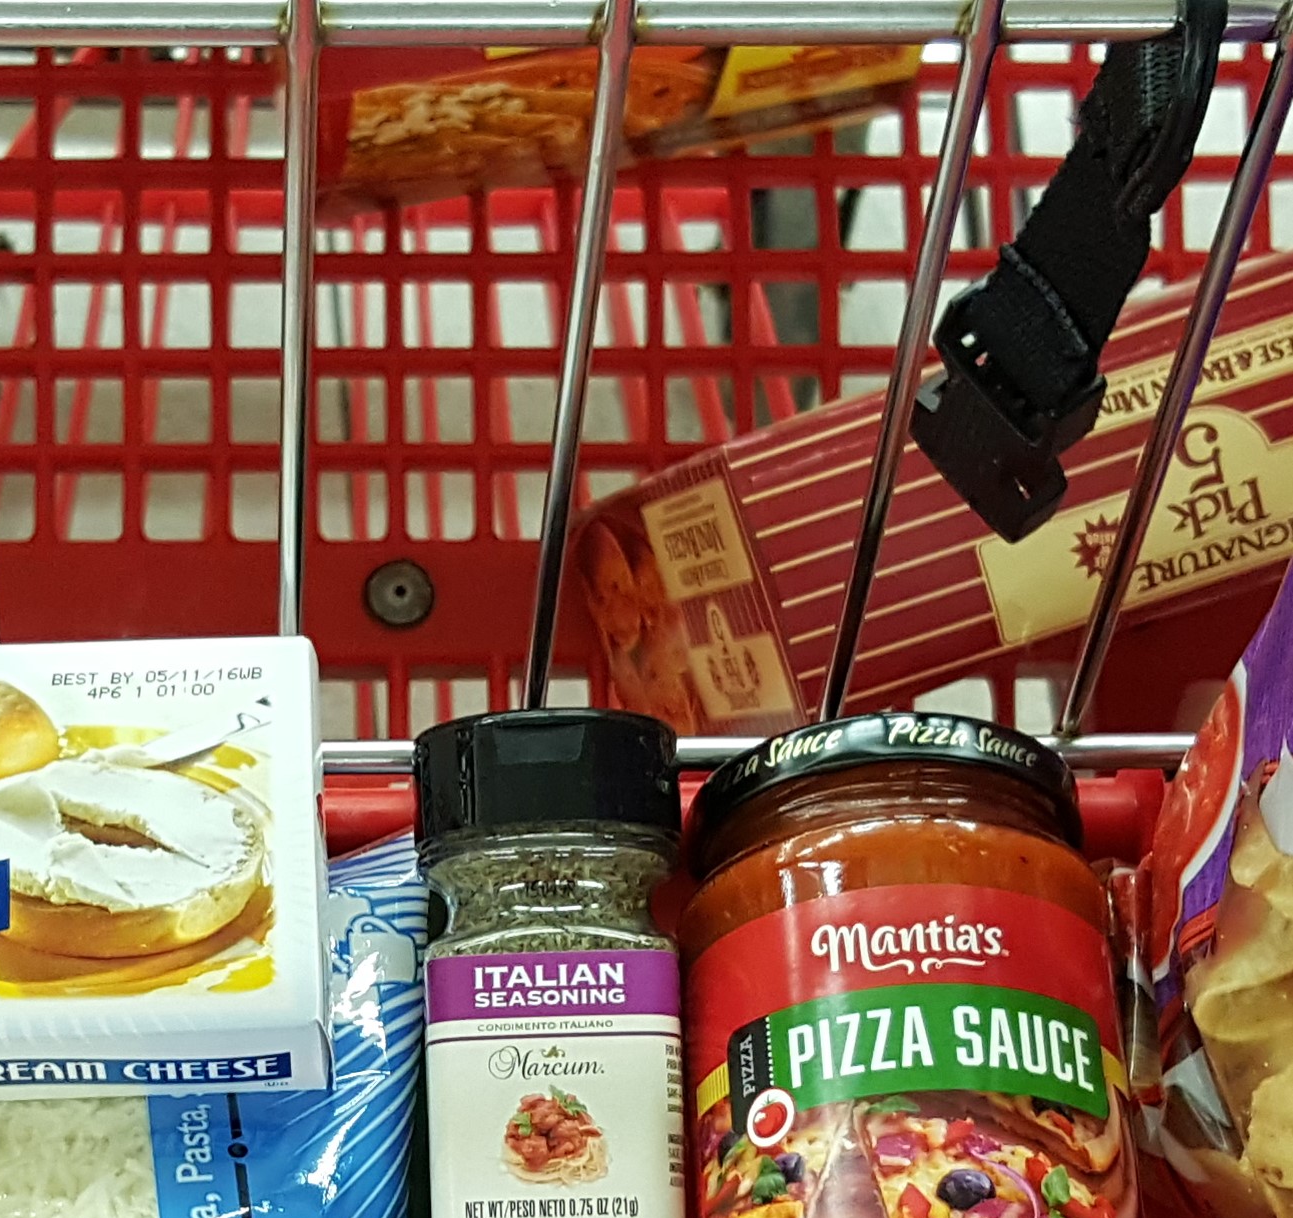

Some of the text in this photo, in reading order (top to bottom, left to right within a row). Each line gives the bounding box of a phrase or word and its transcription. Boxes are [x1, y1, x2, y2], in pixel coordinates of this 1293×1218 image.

[1175, 421, 1225, 495] 5
[1166, 476, 1271, 541] Pick
[51, 666, 264, 687] BEST BY 05/11/16WB
[87, 686, 123, 700] 4P6
[764, 727, 845, 768] Sauce
[888, 716, 970, 748] Pizza
[974, 727, 1039, 768] Sauce
[810, 915, 1005, 976] Mantia's
[474, 962, 625, 990] ITALIAN
[474, 987, 627, 1008] SEASONING
[477, 1019, 614, 1032] CONDIMENTO ITALIANO
[741, 1033, 757, 1099] PIZZA
[787, 1004, 1096, 1093] PIZZA SAUCE
[121, 1056, 281, 1082] CHEESE
[175, 1104, 214, 1184] Pasta,
[539, 1198, 567, 1218] NETO
[569, 1197, 594, 1217] 0.75
[596, 1197, 610, 1216] OZ
[612, 1195, 640, 1218] (21g)
